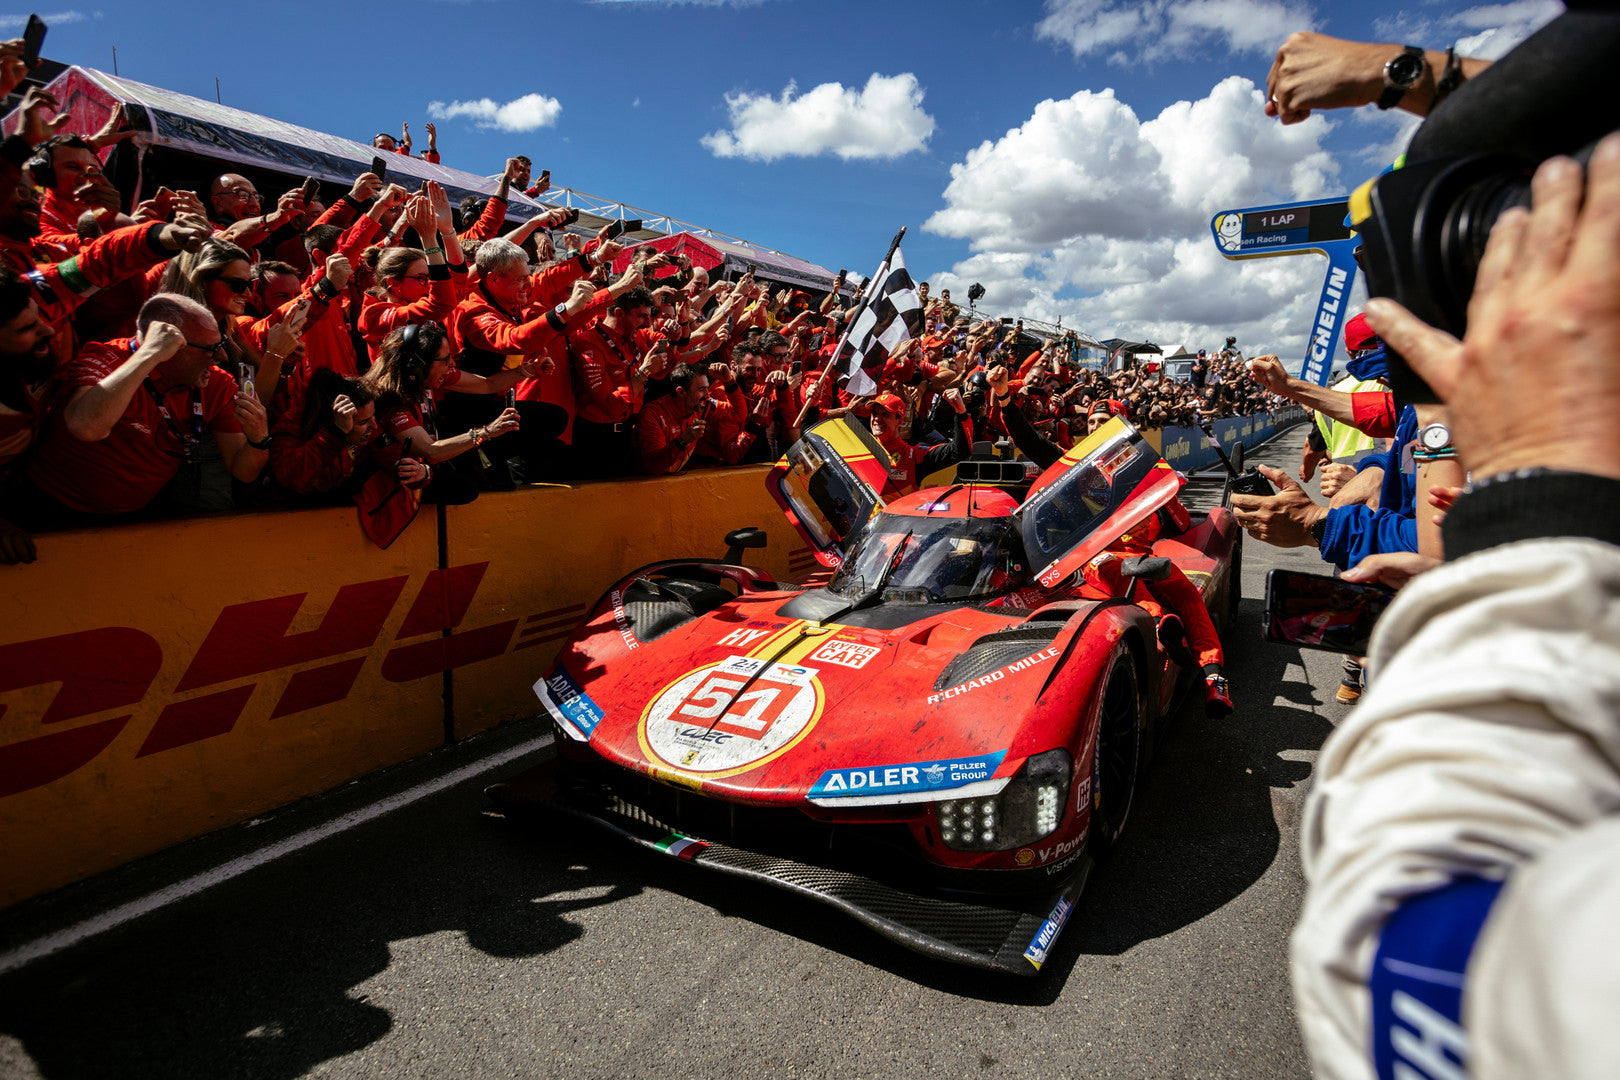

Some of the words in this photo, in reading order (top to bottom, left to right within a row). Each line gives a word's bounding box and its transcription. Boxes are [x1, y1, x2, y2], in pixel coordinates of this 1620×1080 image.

[1261, 217, 1267, 227] 1
[1271, 214, 1295, 226] LAP
[1257, 235, 1287, 245] Racing
[611, 590, 626, 624] RICHARD
[619, 623, 640, 651] MILLE
[716, 628, 770, 647] HY
[816, 648, 867, 666] CAR
[827, 641, 875, 655] HYPER
[927, 670, 1005, 704] RICHARD
[1008, 647, 1060, 675] MILLE
[546, 675, 581, 709] ADLER
[679, 677, 782, 731] 51
[949, 762, 987, 771] PELZER
[951, 771, 987, 781] GROUP
[823, 767, 919, 792] ADLER
[1037, 900, 1071, 947] MICHELIN
